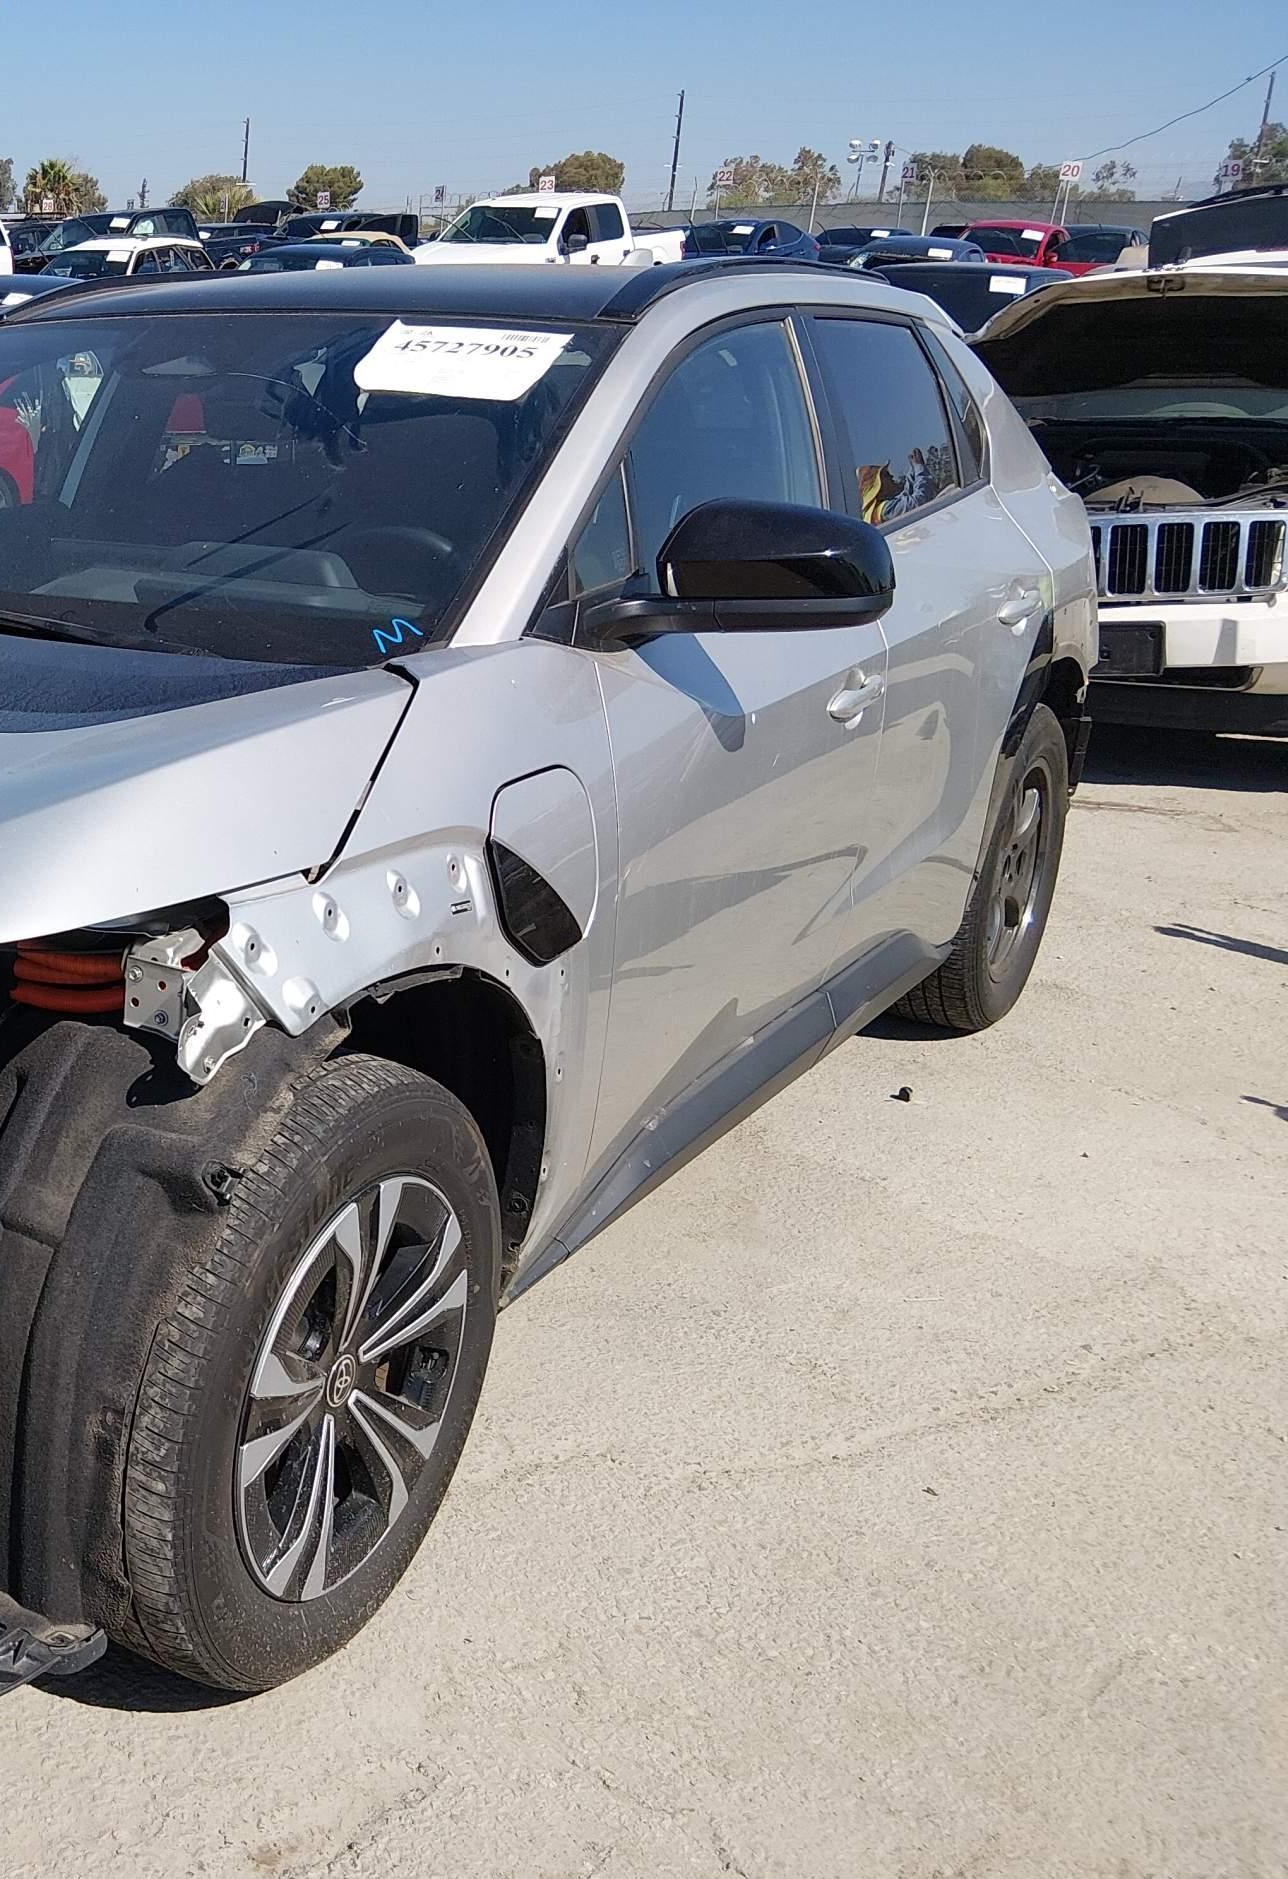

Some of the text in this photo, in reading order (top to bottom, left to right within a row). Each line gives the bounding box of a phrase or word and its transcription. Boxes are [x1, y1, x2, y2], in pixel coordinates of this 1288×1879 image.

[718, 170, 732, 181] 22
[902, 166, 915, 178] 21
[1061, 164, 1080, 177] 20
[1221, 163, 1241, 176] 19
[540, 180, 553, 190] 23
[318, 195, 329, 205] 25
[394, 339, 540, 359] 45727905
[372, 618, 424, 654] M
